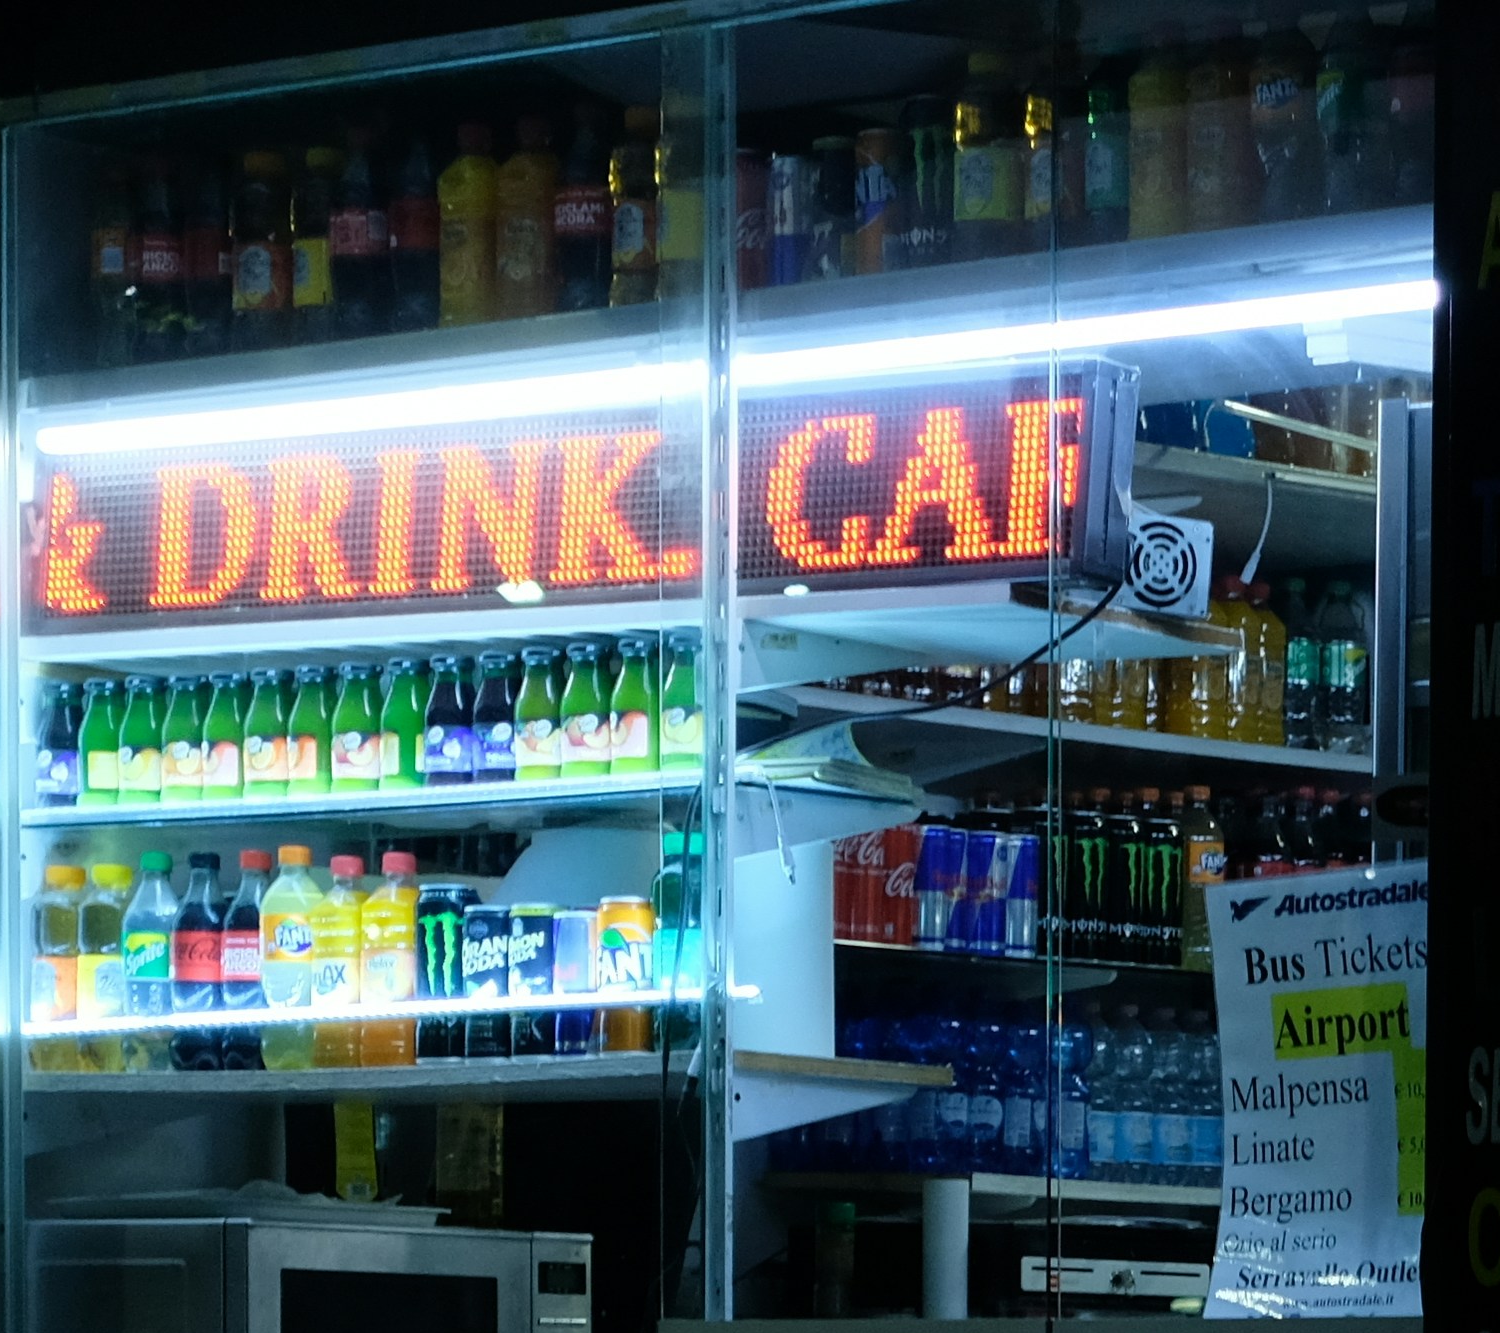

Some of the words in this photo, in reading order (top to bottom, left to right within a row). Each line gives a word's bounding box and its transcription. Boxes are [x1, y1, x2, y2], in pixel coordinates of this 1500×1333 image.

[149, 430, 697, 607] DRINK
[1243, 945, 1306, 985] Bus
[1313, 933, 1428, 977] Tickets
[1274, 998, 1411, 1055] Airport
[1230, 1074, 1370, 1119] Malpensa
[1231, 1132, 1316, 1166] Linate
[1229, 1184, 1353, 1224] Bergamo
[1270, 1230, 1287, 1251] al
[1291, 1227, 1337, 1250] serio
